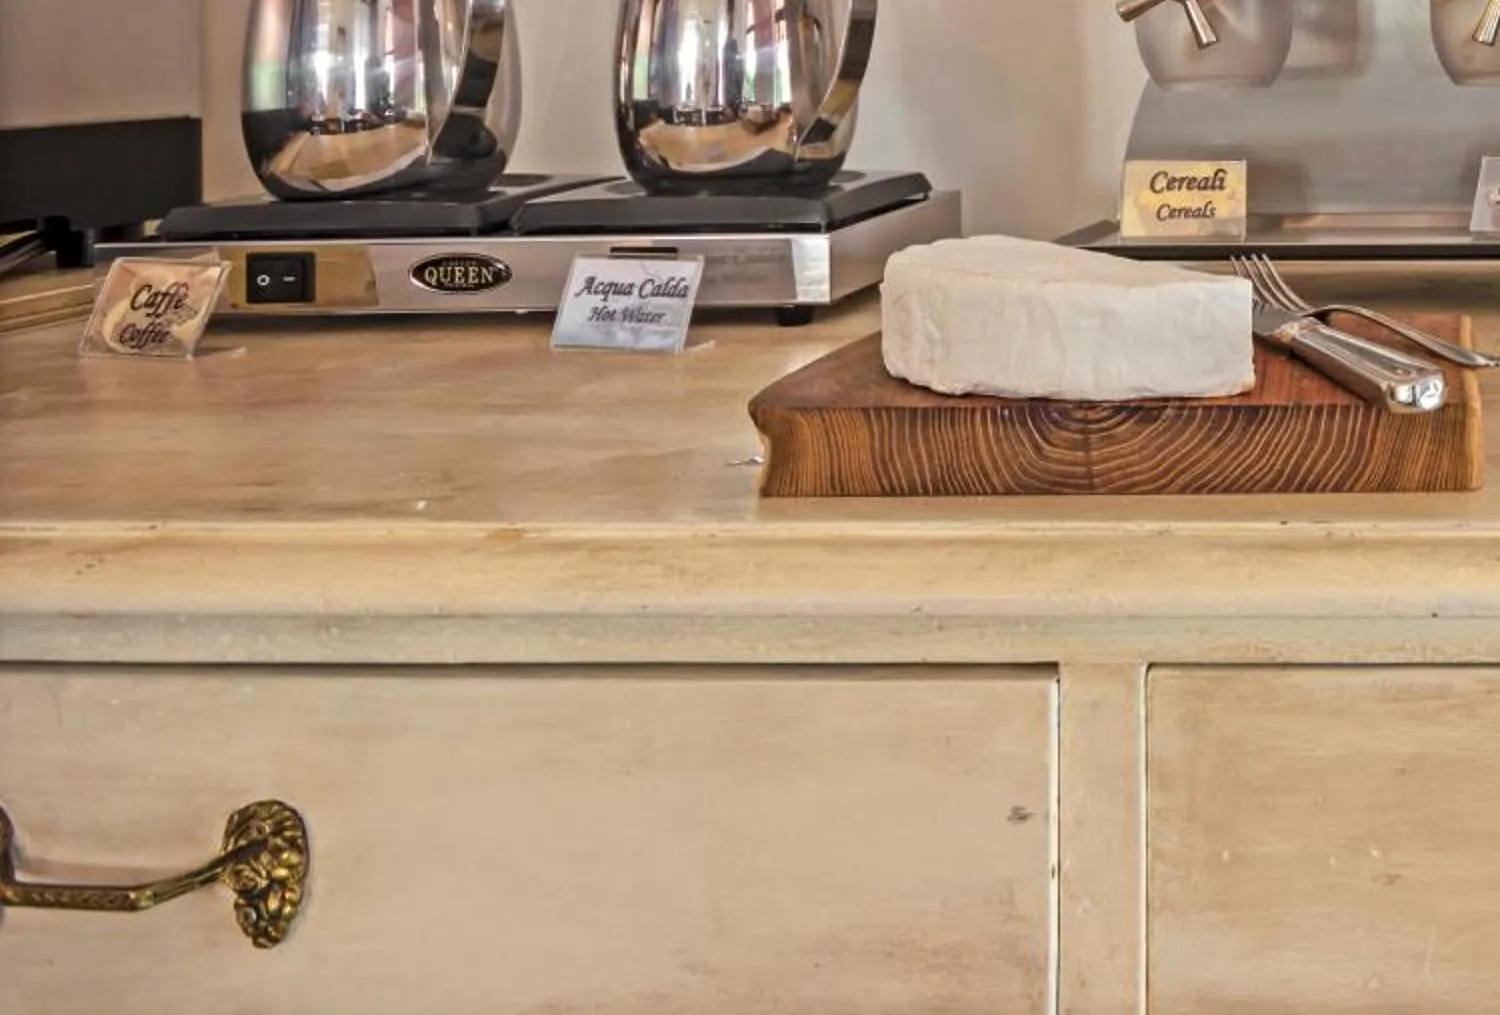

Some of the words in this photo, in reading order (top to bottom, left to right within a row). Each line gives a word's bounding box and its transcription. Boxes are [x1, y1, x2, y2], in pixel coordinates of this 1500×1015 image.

[1149, 168, 1228, 194] Cereali
[1156, 201, 1216, 222] Cereals
[424, 266, 495, 286] QUEEN
[573, 276, 633, 302] Acqua
[637, 276, 690, 300] Calda
[588, 306, 617, 323] Hot
[620, 306, 666, 324] Water
